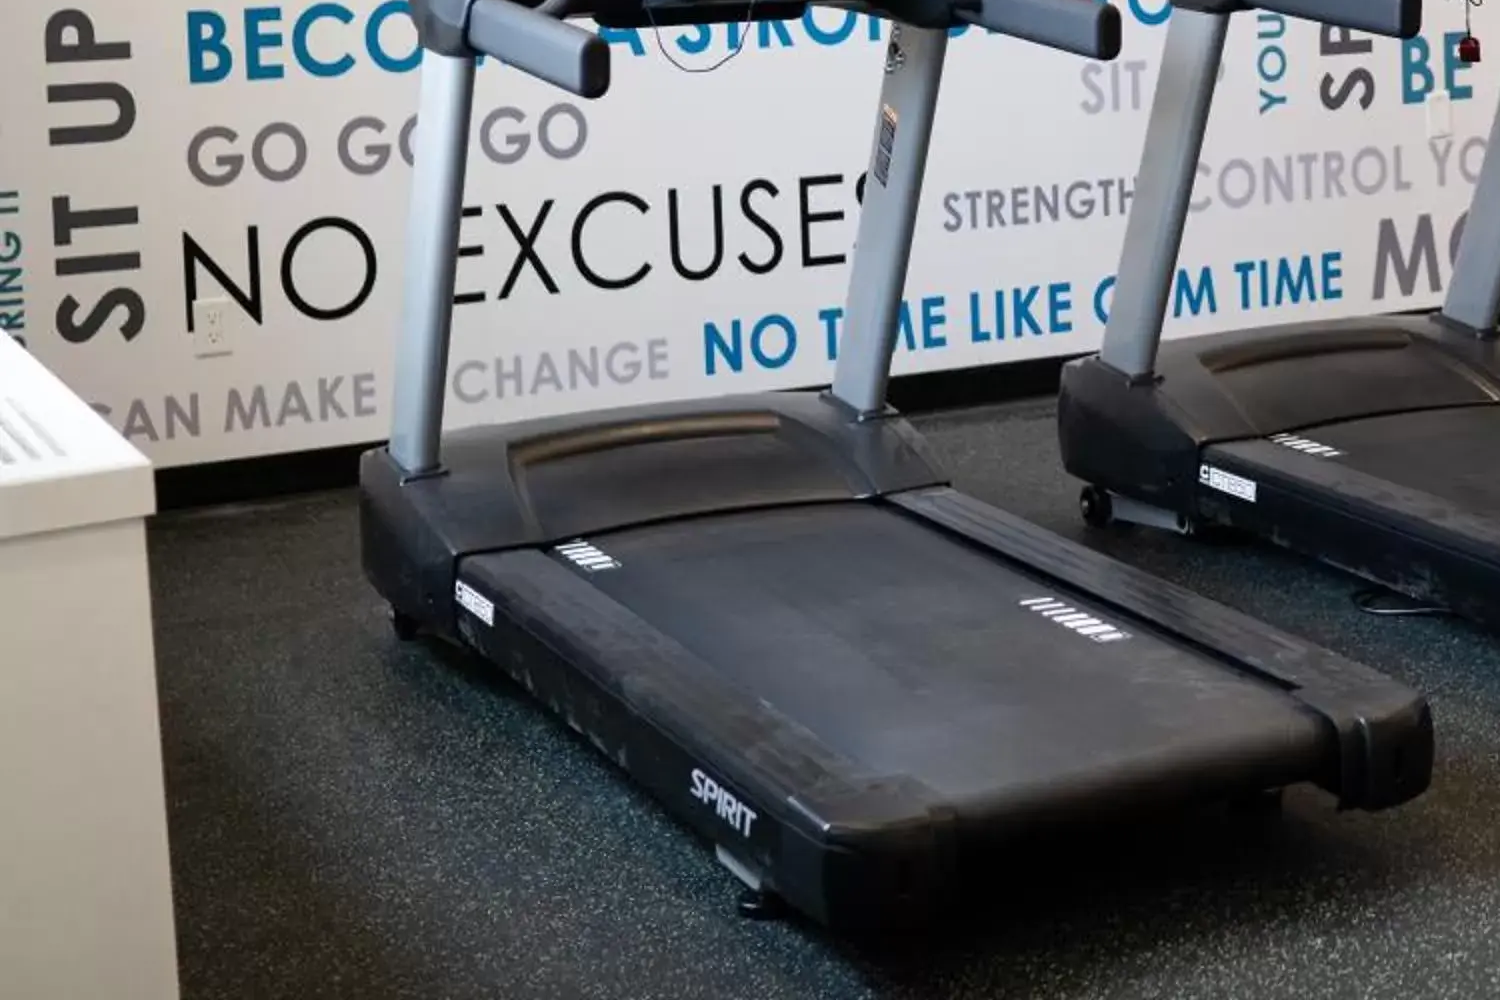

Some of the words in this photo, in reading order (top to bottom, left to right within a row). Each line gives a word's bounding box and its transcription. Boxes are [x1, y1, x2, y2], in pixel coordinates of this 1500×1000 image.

[45, 8, 136, 146] UP
[187, 0, 430, 84] BECO
[1402, 32, 1473, 104] BE
[1080, 60, 1148, 114] SIT
[187, 125, 307, 187] GO
[480, 102, 588, 165] GO
[1187, 145, 1412, 213] CONTROL
[943, 176, 1138, 233] STRENGTH
[0, 230, 27, 349] RING
[52, 194, 145, 343] SIT
[182, 216, 377, 335] NO
[451, 172, 868, 306] EXCUSE
[1234, 251, 1343, 310] TIME
[704, 315, 796, 377] NO
[970, 282, 1072, 344] LIKE
[452, 338, 669, 404] CHANGE
[88, 392, 201, 442] AN
[224, 373, 377, 431] MAKE
[690, 767, 758, 839] SPIRIT
